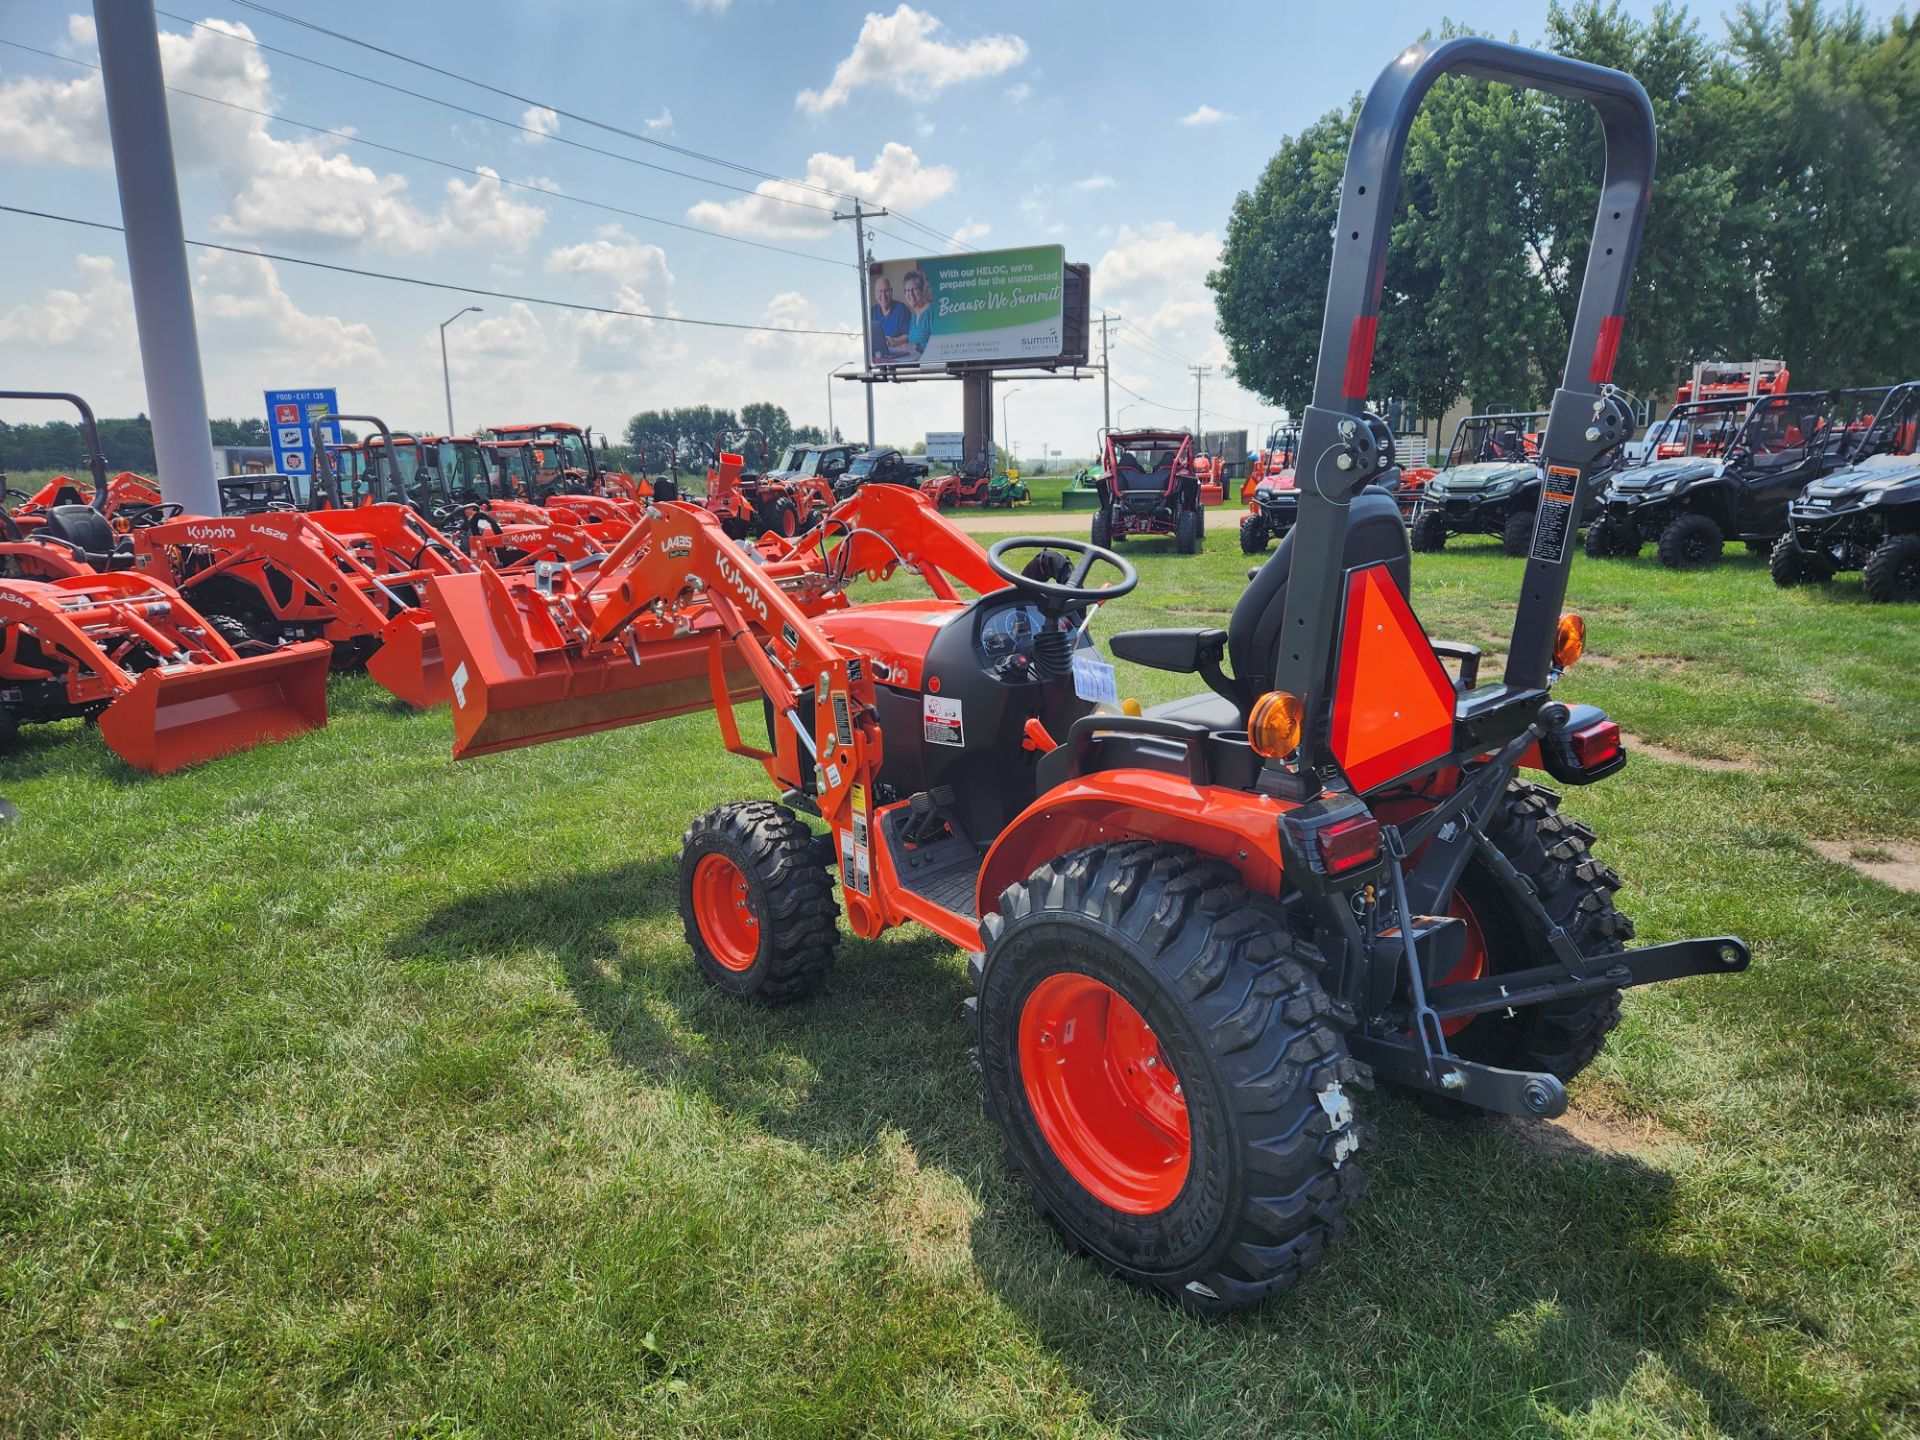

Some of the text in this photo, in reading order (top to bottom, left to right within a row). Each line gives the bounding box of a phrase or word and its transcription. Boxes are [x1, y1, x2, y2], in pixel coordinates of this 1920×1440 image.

[940, 264, 1034, 279] With our HELOC, we're
[940, 271, 1059, 290] prepared for the unexpected.
[939, 284, 1061, 317] Because We Summit
[1021, 336, 1058, 345] summit
[187, 524, 236, 539] Kubota
[250, 524, 288, 541] LA526
[511, 532, 542, 542] Kubota
[661, 536, 692, 553] LA435
[716, 550, 768, 621] Kubota
[0, 592, 32, 608] A344
